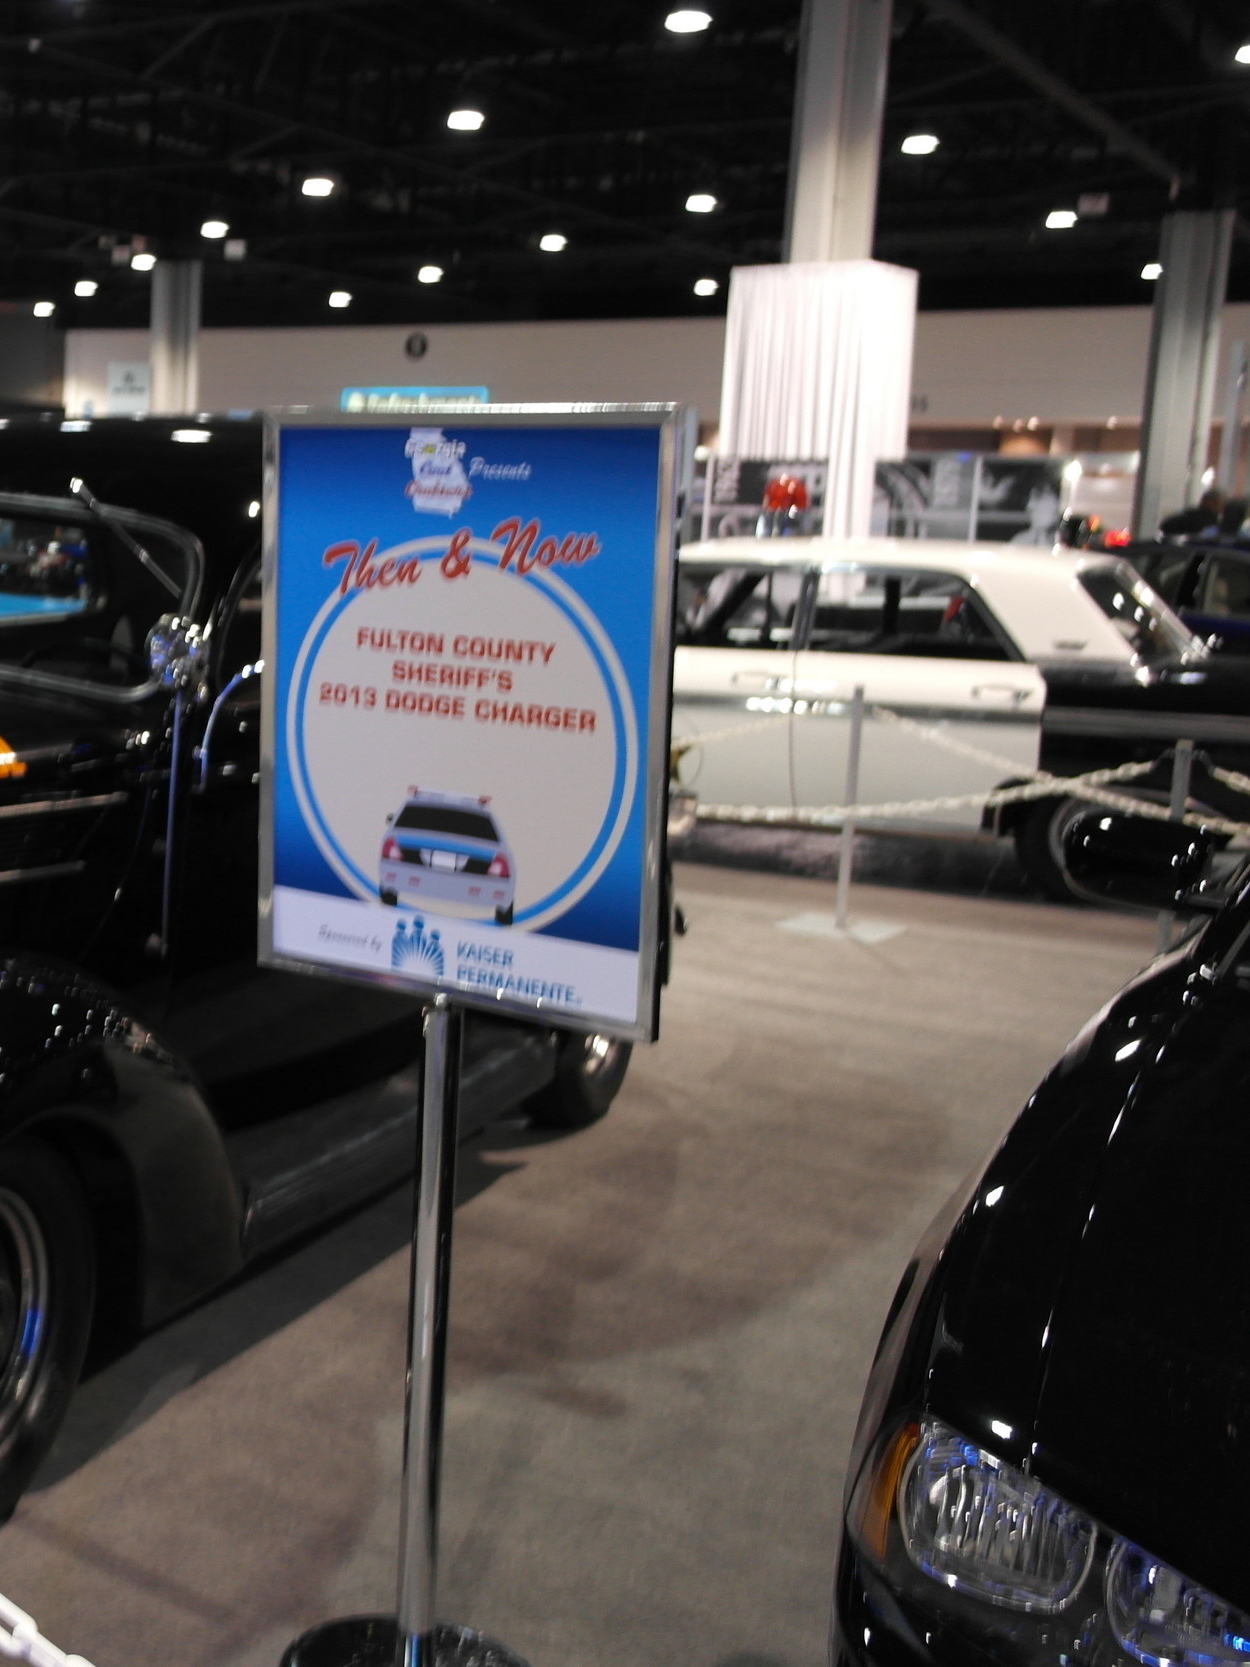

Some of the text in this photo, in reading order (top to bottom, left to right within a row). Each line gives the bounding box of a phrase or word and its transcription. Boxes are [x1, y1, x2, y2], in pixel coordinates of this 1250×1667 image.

[468, 456, 532, 480] Presents
[322, 517, 601, 596] Then & Now
[356, 626, 556, 665] FULTON COUNTY
[392, 660, 513, 692] SHERIFF'S
[319, 681, 597, 733] 2013 DODGE CHARGER
[456, 940, 514, 967] KAISER
